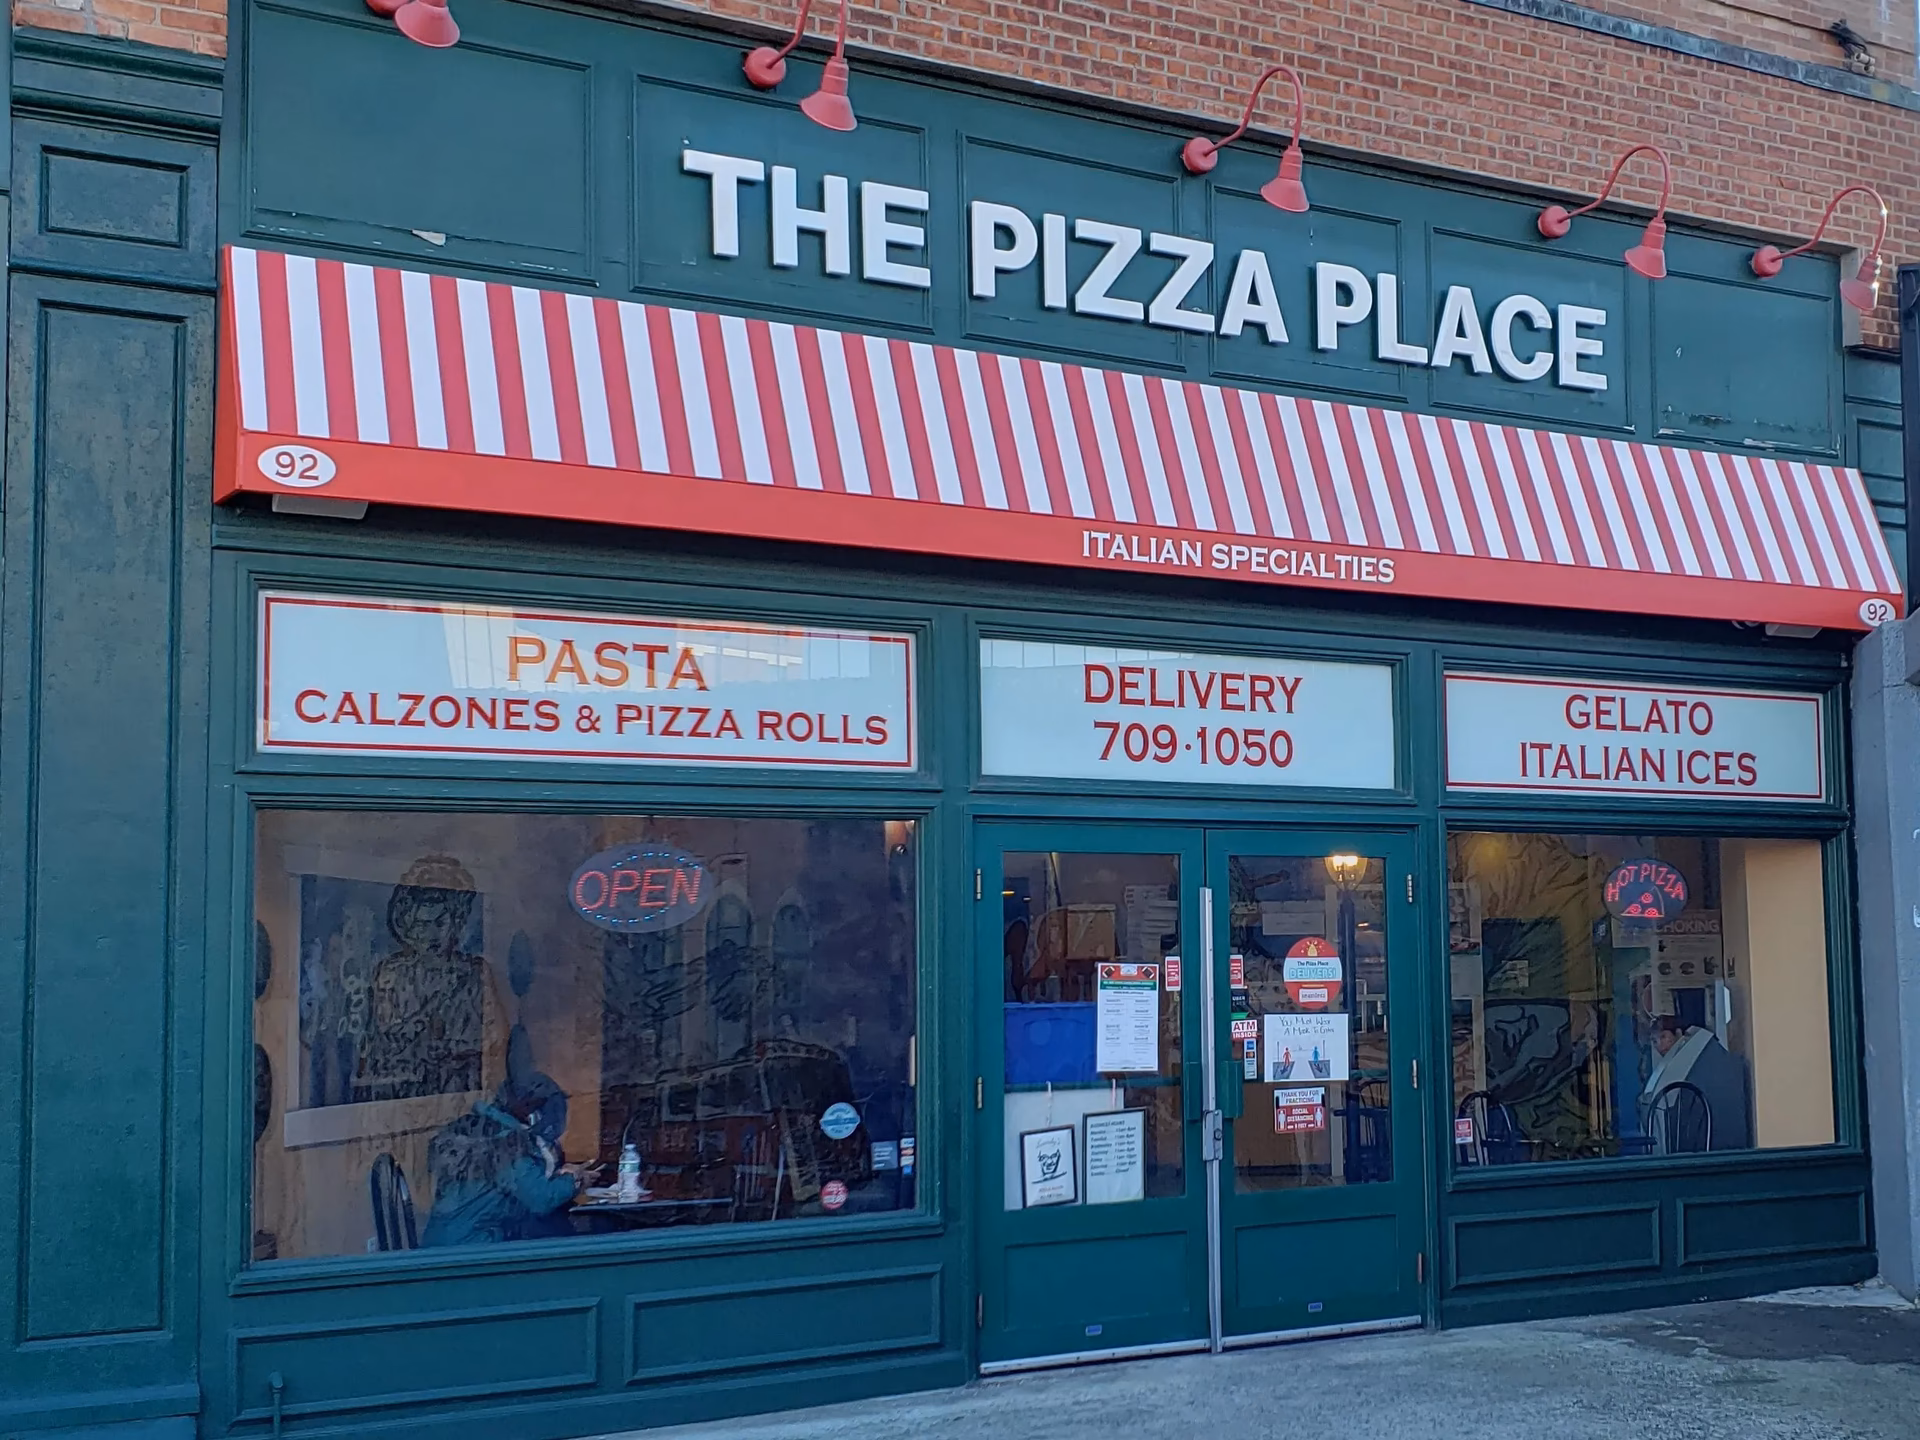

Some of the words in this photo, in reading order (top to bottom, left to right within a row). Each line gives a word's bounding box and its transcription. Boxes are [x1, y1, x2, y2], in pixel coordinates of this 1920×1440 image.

[682, 149, 932, 289] THE
[970, 200, 1290, 345] PIZZA
[1315, 260, 1609, 392] PLACE
[273, 451, 321, 481] 92
[1081, 530, 1205, 570] ITALIAN
[1210, 542, 1396, 585] SPECIALTIES
[1867, 602, 1888, 622] 92
[506, 635, 709, 692] PASTA
[1082, 662, 1304, 715] DELIVERY
[293, 688, 561, 734] CALZONES
[574, 705, 602, 735] &
[614, 703, 742, 741] PIZZA
[755, 711, 889, 747] ROLLS
[1564, 693, 1714, 737] GELATO
[1518, 742, 1666, 784] ITALIAN
[1676, 749, 1758, 786] ICES
[574, 867, 703, 911] OPEN
[1607, 865, 1639, 903] HOT
[1639, 863, 1686, 902] PIZZA
[1655, 919, 1720, 935] CHOKING
[1289, 967, 1337, 980] DELIVERS!
[1232, 1031, 1257, 1039] INSIDE
[1233, 1021, 1256, 1032] ATM
[1281, 1091, 1298, 1099] THANK
[1298, 1090, 1309, 1098] YOU
[1309, 1089, 1320, 1097] FOR
